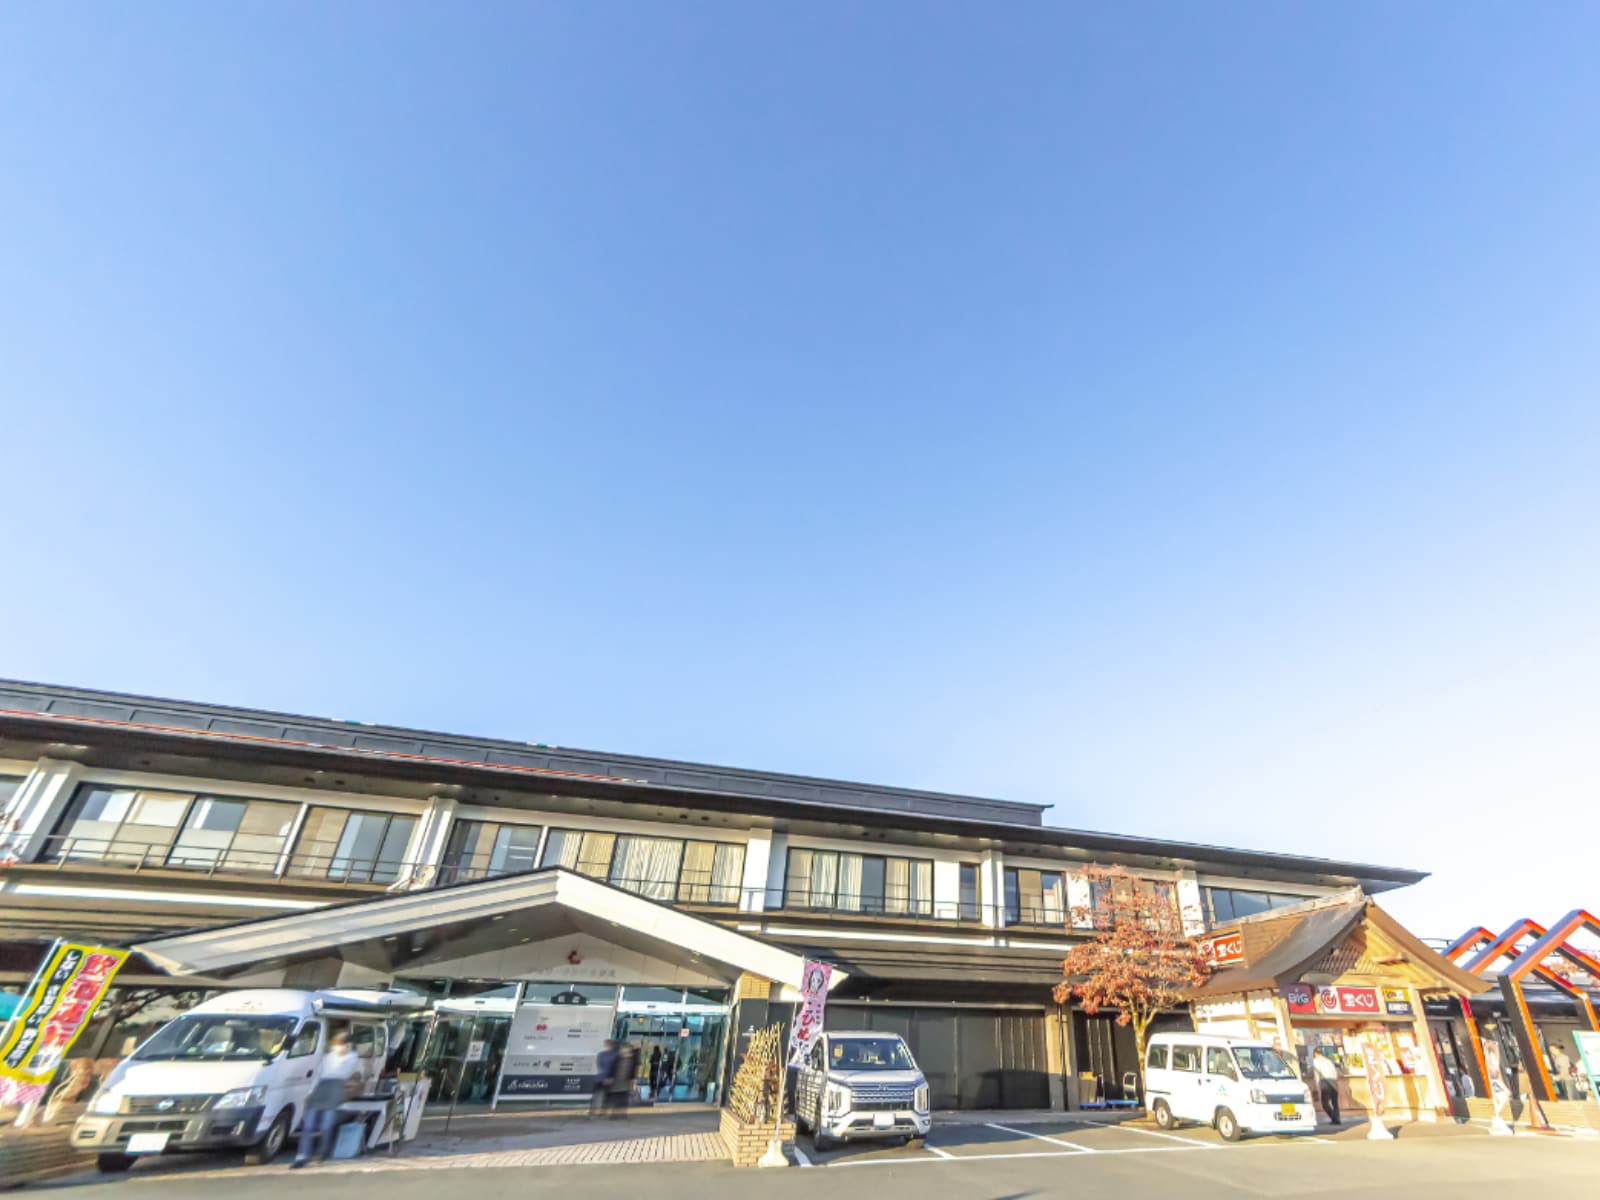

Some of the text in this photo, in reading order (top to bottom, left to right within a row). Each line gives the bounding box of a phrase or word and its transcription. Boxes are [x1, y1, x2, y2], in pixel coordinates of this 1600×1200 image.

[1288, 992, 1309, 1004] BIG
[1342, 993, 1374, 1008] 宝くじ
